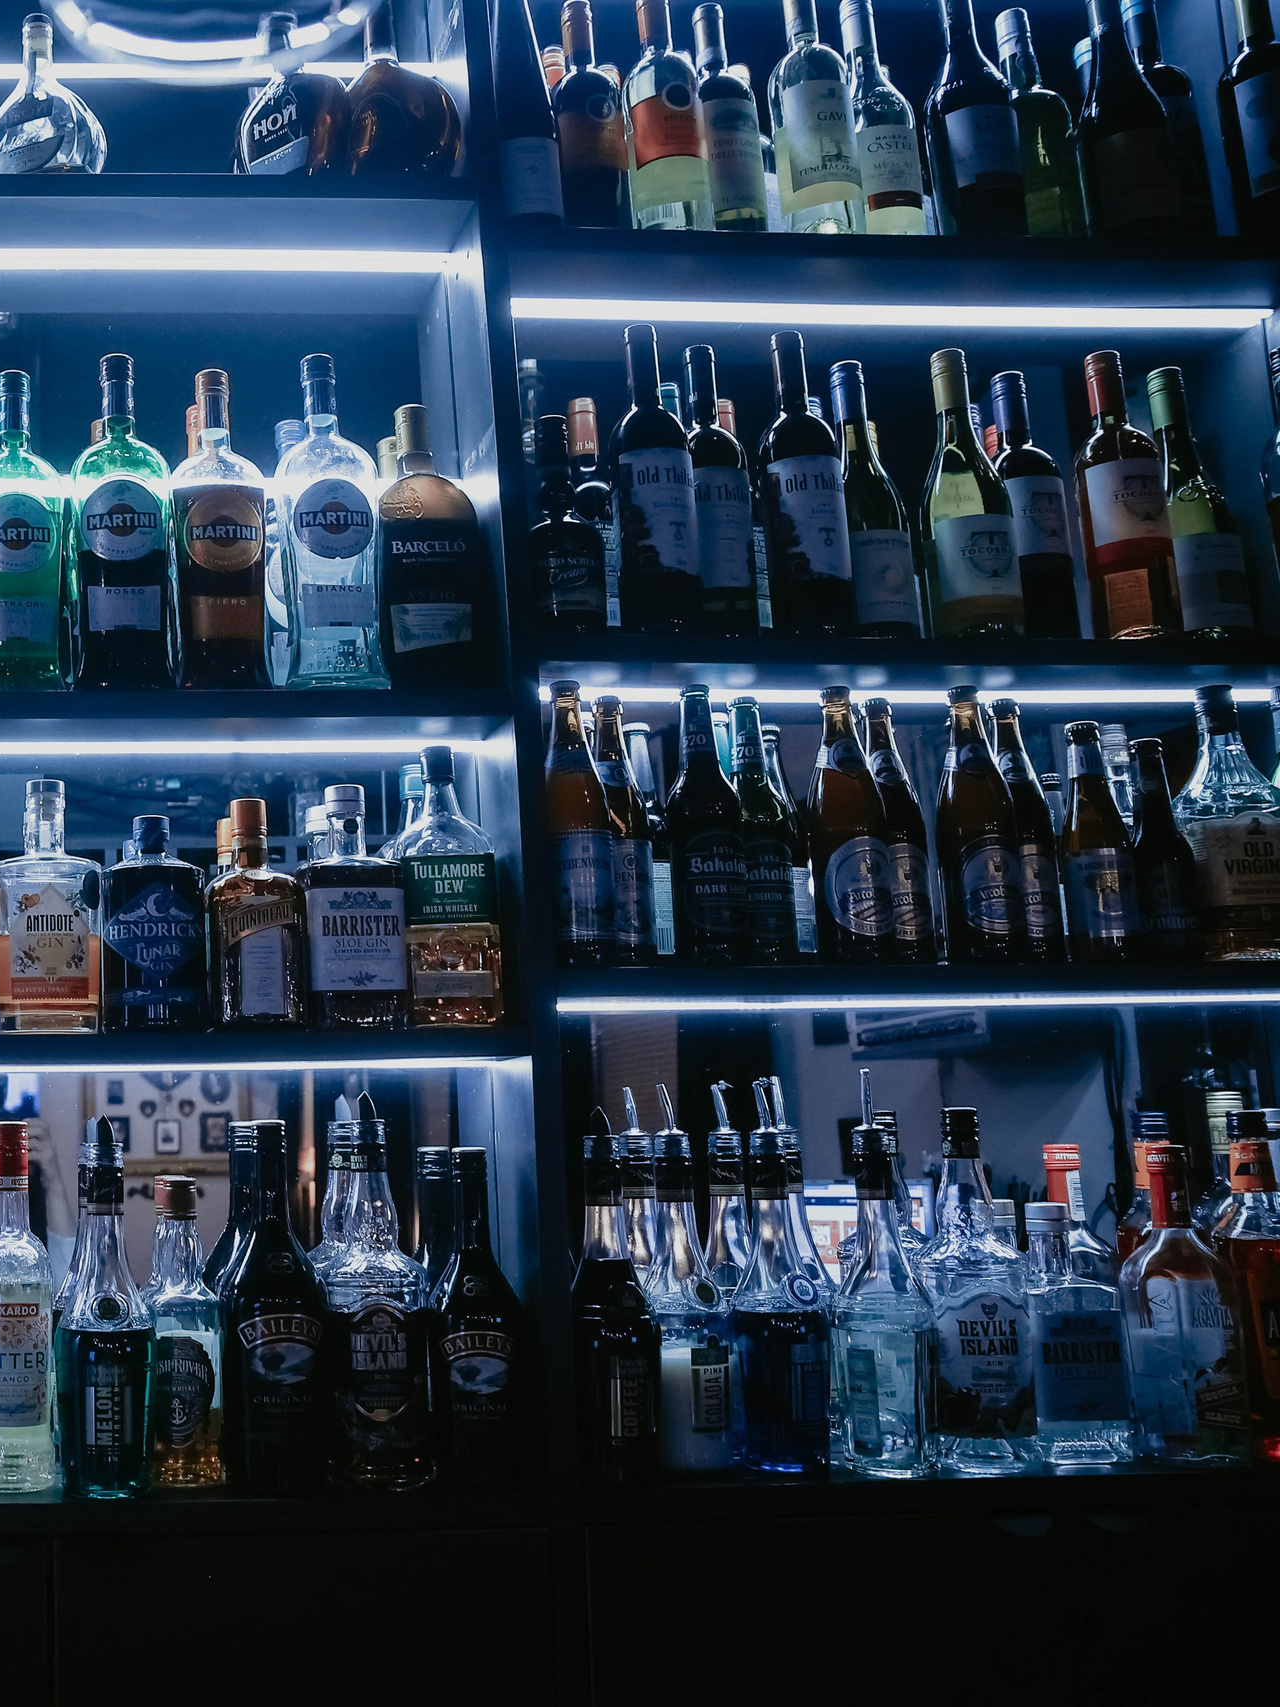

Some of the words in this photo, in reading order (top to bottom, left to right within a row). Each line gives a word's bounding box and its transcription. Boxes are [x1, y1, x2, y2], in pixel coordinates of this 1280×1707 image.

[817, 111, 847, 123] GAVI
[867, 141, 913, 154] CASTEL
[637, 466, 658, 486] Old
[785, 473, 808, 493] Old
[302, 511, 367, 526] MARTINI
[1021, 505, 1062, 516] TOCOR
[89, 513, 155, 528] MARTINI
[192, 526, 256, 540] MARTINI
[392, 538, 466, 554] BARCELÓ
[317, 585, 362, 593] BIANCO
[26, 601, 46, 609] DRY
[730, 745, 754, 759] 570
[1244, 841, 1274, 857] OLD
[410, 861, 486, 880] TULLAMORE
[1224, 859, 1280, 875] VIRGIN
[695, 884, 728, 895] DARK
[422, 904, 443, 914] IRISH
[445, 903, 478, 914] WHISKEY
[26, 914, 73, 932] ANTIDOTE
[230, 904, 290, 939] COINTREAU
[321, 915, 401, 936] BARRISTER
[36, 937, 64, 949] GIN
[335, 939, 362, 948] SLOE
[366, 939, 389, 948] GIN
[135, 941, 181, 964] LUNAR
[150, 961, 174, 970] GIN
[243, 1318, 318, 1341] BAILEYS
[956, 1318, 1017, 1337] DEVIL'S
[350, 1332, 407, 1351] DEVIL'S
[444, 1335, 512, 1354] BAILEYS
[960, 1338, 1018, 1355] ISLAND
[1042, 1341, 1121, 1364] BARRISTER
[352, 1351, 407, 1371] ISLAND
[1055, 1365, 1083, 1377] DRY
[1087, 1365, 1114, 1377] GIN
[706, 1376, 722, 1425] COLADA
[1200, 1387, 1239, 1403] TEQUILA
[96, 1386, 114, 1446] MELON
[622, 1379, 639, 1438] COFFEE
[1205, 1412, 1241, 1424] BLANCO
